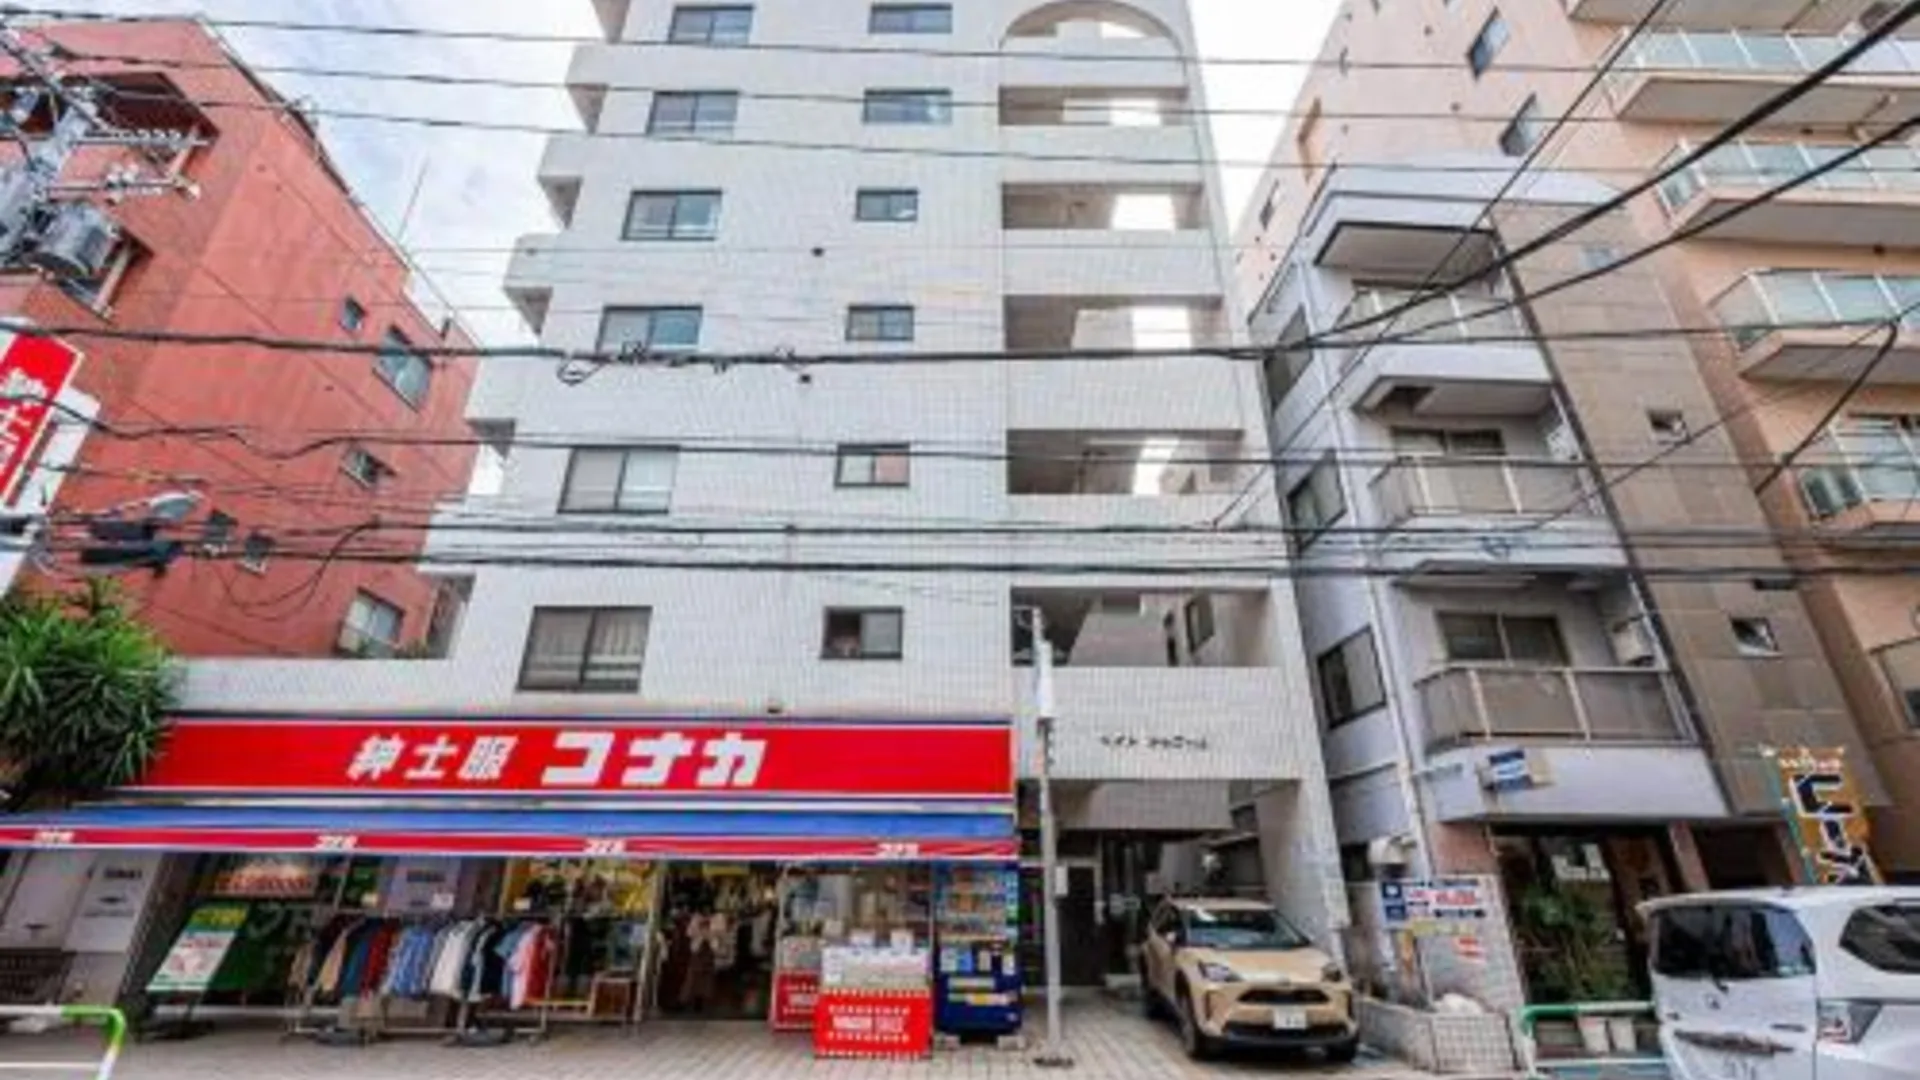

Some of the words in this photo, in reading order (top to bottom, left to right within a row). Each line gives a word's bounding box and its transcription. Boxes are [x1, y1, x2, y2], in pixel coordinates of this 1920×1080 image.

[347, 734, 519, 780] 紳士服
[541, 731, 768, 786] コナカ
